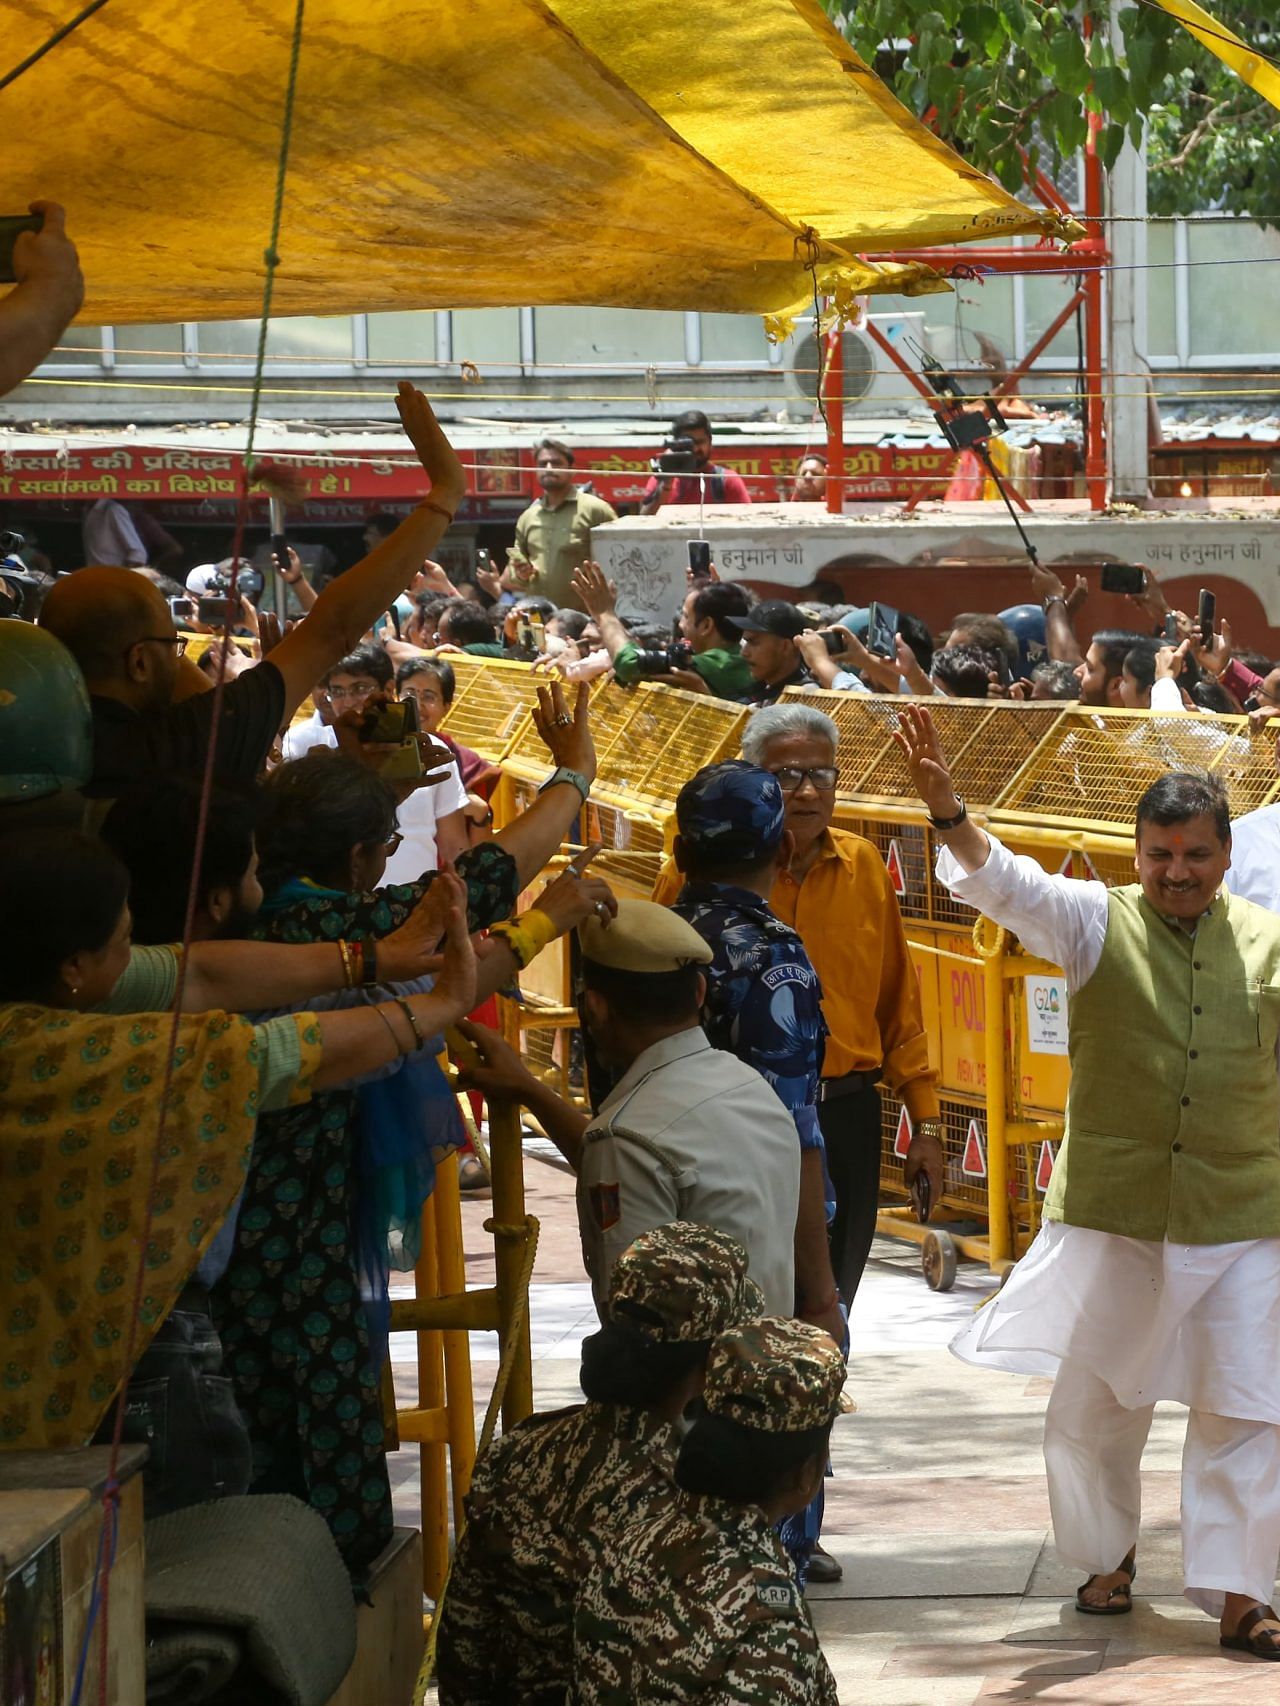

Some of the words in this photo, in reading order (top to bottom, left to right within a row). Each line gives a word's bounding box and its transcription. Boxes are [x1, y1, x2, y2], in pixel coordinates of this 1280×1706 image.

[92, 451, 133, 469] की
[18, 475, 118, 493] सवामनी
[126, 478, 161, 492] का
[169, 474, 236, 493] विशेष
[720, 548, 777, 571] हनुमान
[782, 543, 804, 565] जी
[1144, 543, 1173, 560] जय
[1179, 543, 1235, 565] हनुमान
[1240, 538, 1263, 560] जी
[951, 969, 986, 1032] POLI
